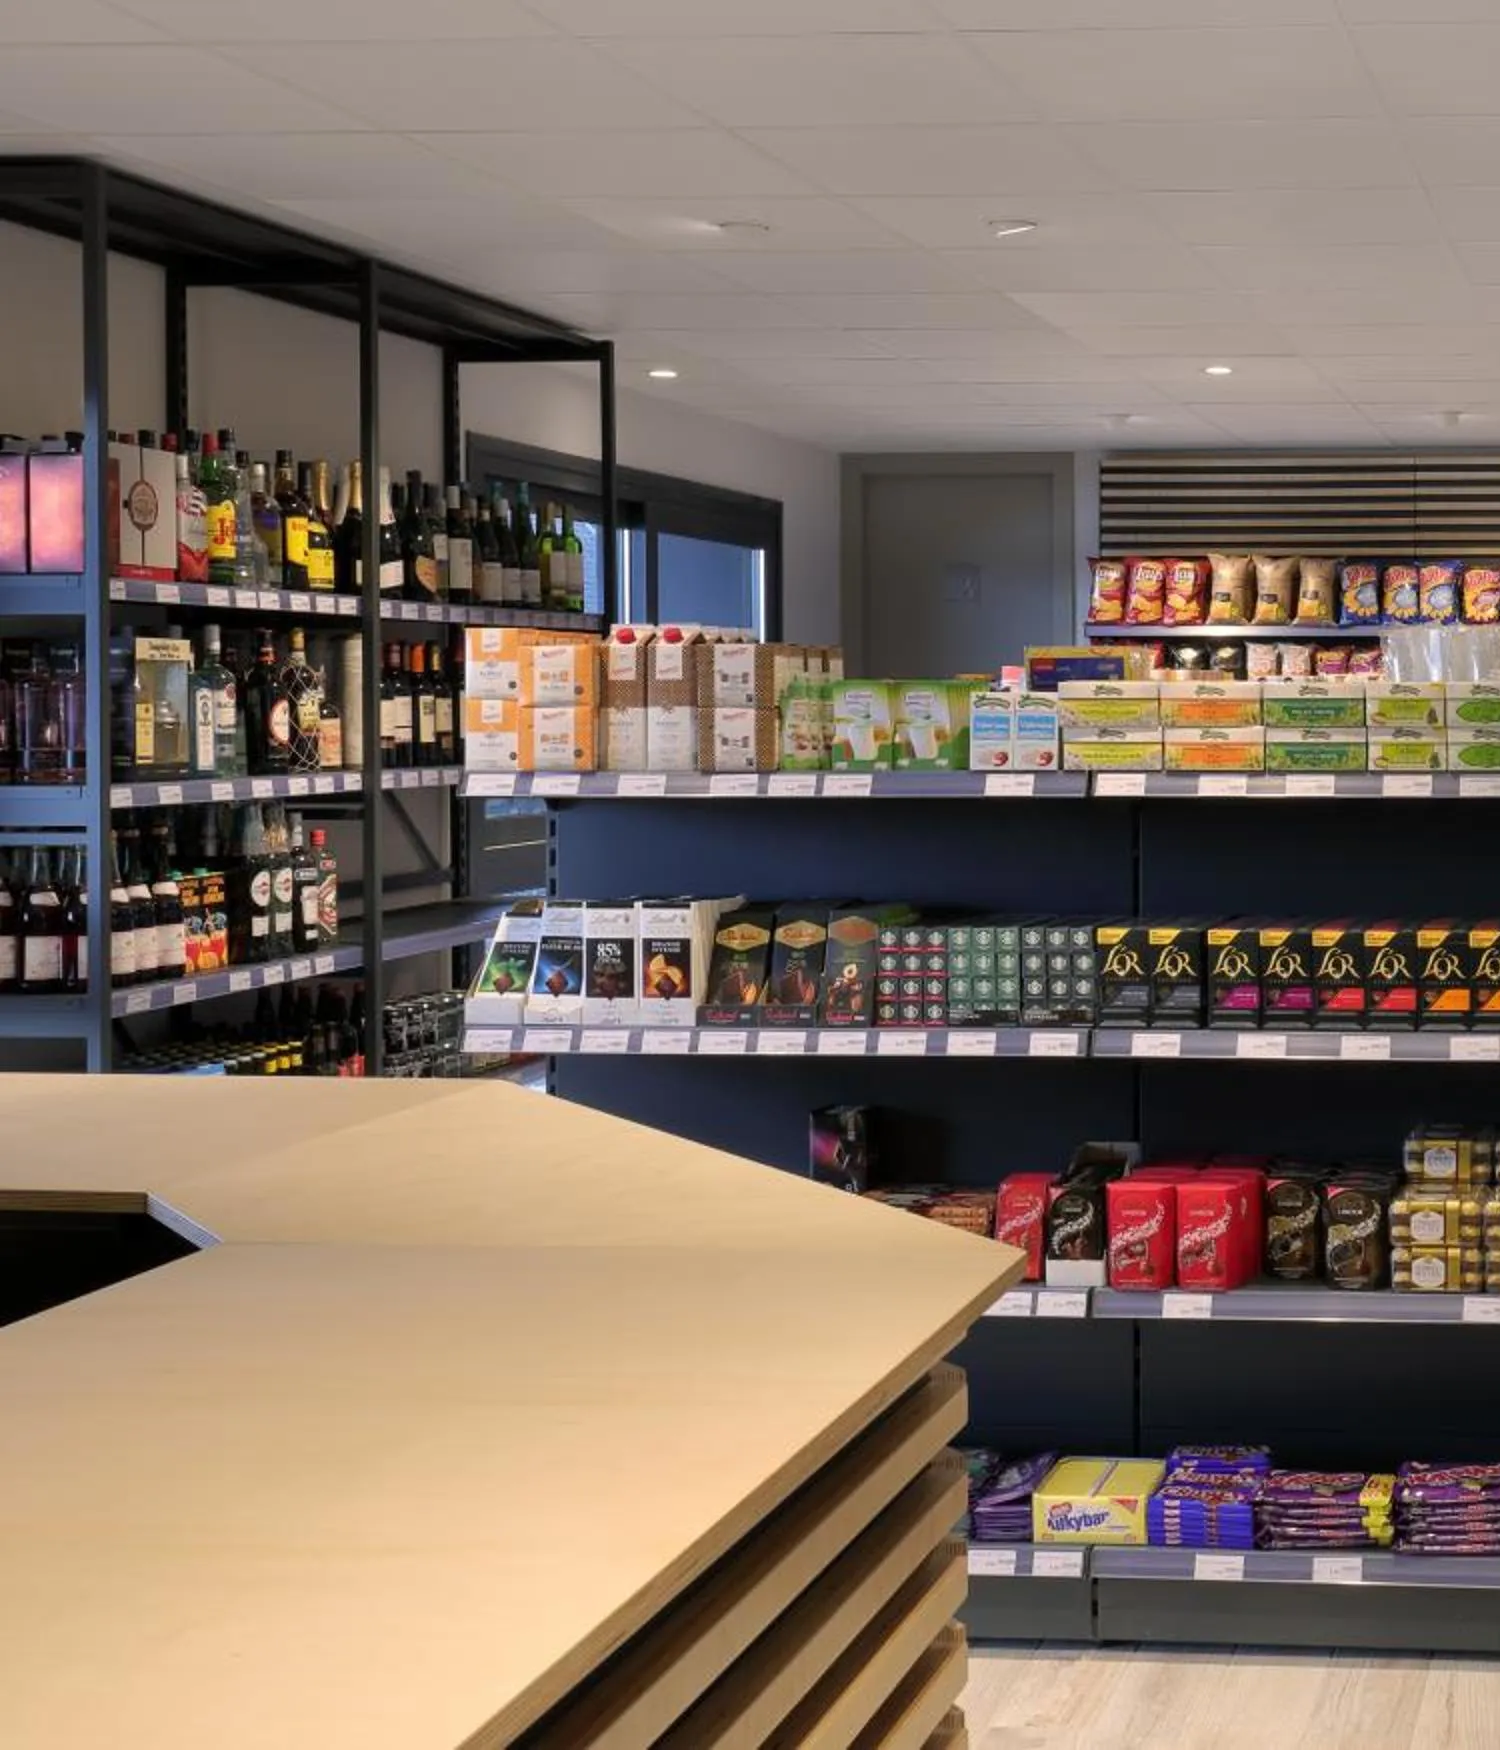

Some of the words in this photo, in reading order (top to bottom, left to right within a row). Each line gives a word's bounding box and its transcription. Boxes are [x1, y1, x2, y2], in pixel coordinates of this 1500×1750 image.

[597, 943, 621, 957] 85%
[1101, 943, 1145, 977] L'OR
[1152, 945, 1197, 978] L'OR
[1212, 945, 1256, 977] L'OR
[1263, 946, 1309, 978] L'OR
[1316, 947, 1361, 979] L'OR
[1368, 947, 1413, 979] L'OR
[1420, 947, 1467, 980] L'OR
